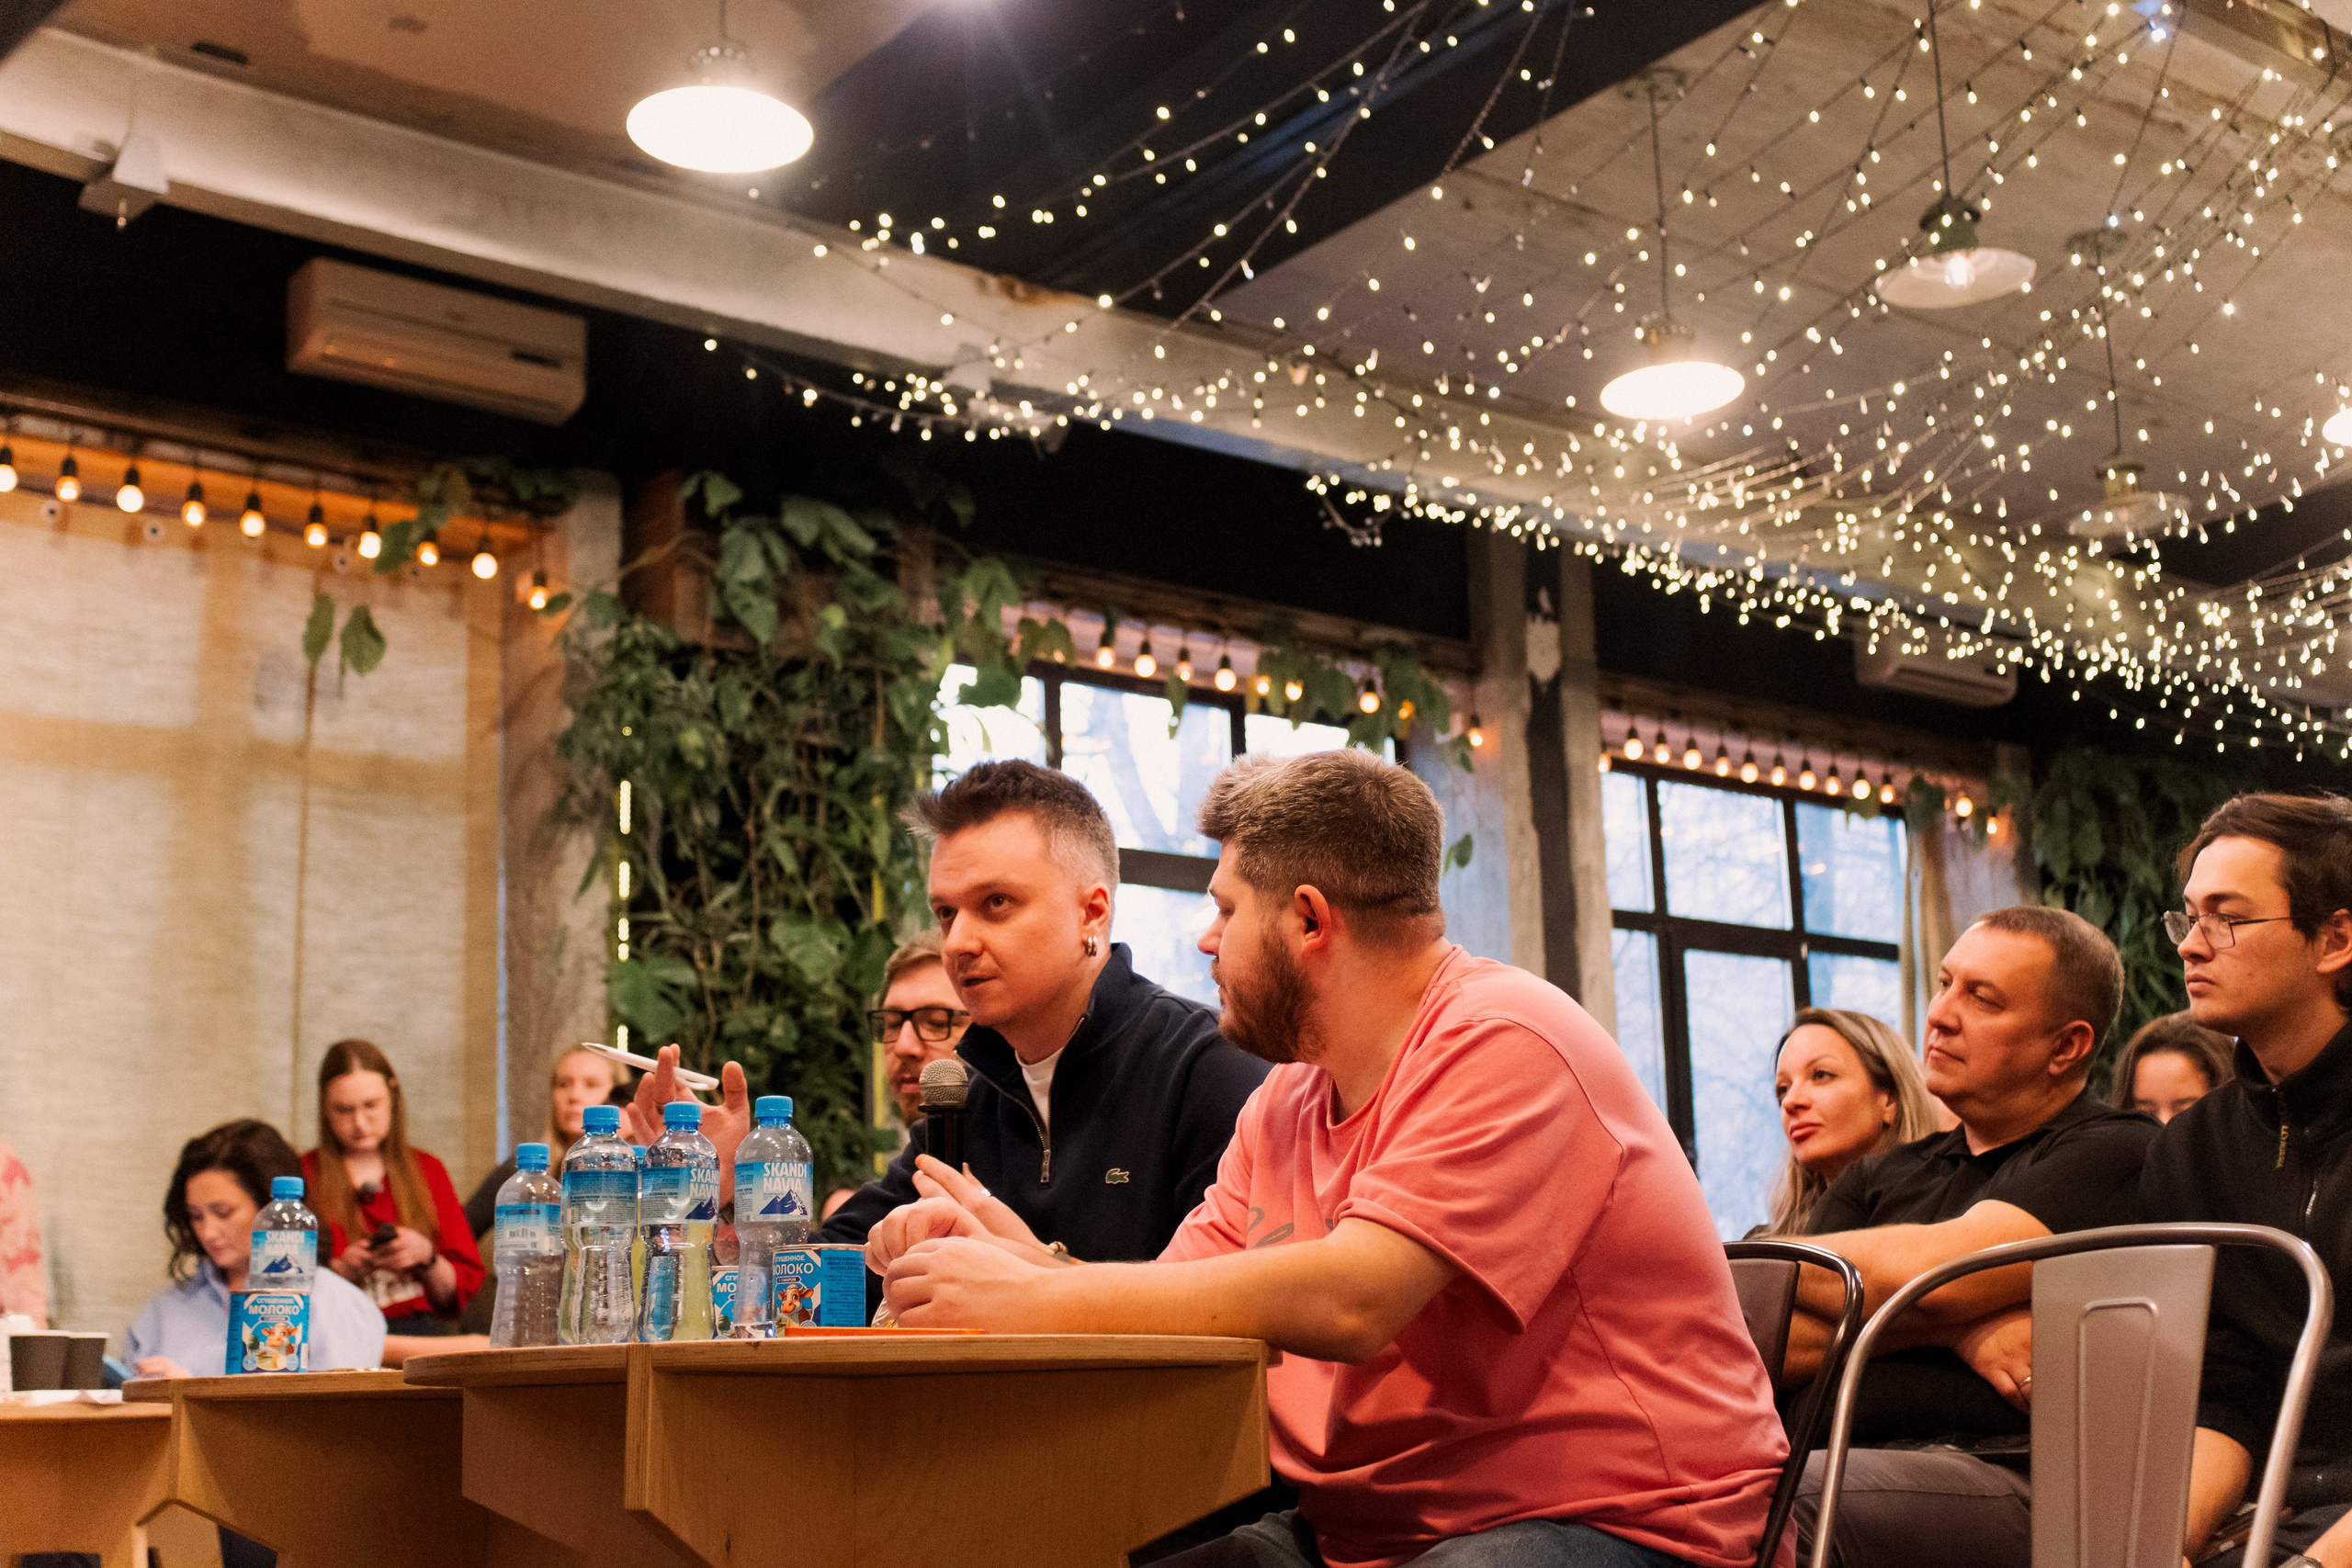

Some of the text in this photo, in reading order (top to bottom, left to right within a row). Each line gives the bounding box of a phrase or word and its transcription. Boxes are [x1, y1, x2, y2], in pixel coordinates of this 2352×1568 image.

[763, 1162, 807, 1178] SKANDI
[763, 1178, 802, 1192] NAVIA
[248, 1304, 300, 1315] МОЛОКО
